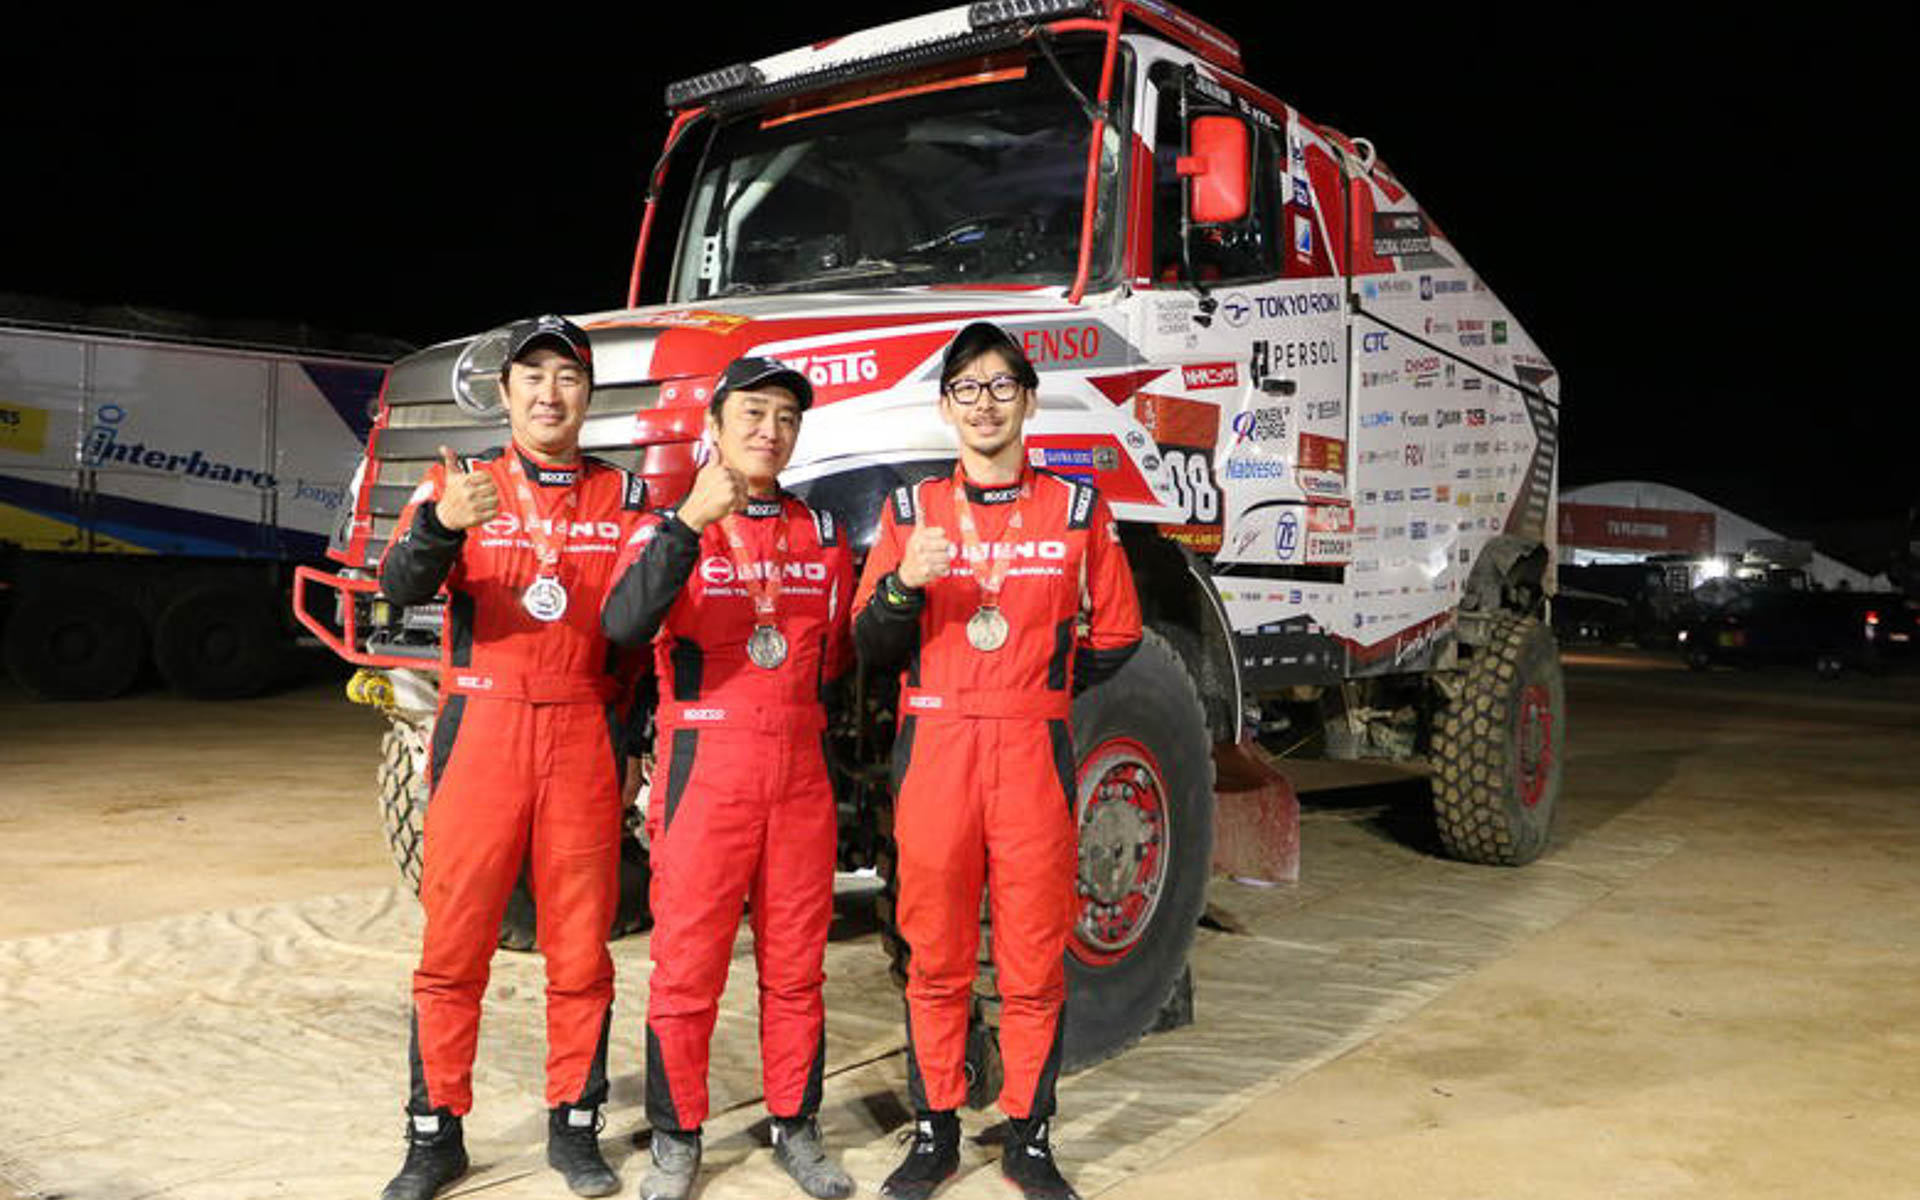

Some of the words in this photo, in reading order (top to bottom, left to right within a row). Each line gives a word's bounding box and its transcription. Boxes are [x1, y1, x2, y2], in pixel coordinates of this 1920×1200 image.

[1022, 326, 1100, 362] ENSO
[1274, 341, 1338, 370] PERSOL
[1277, 521, 1297, 550] ZF
